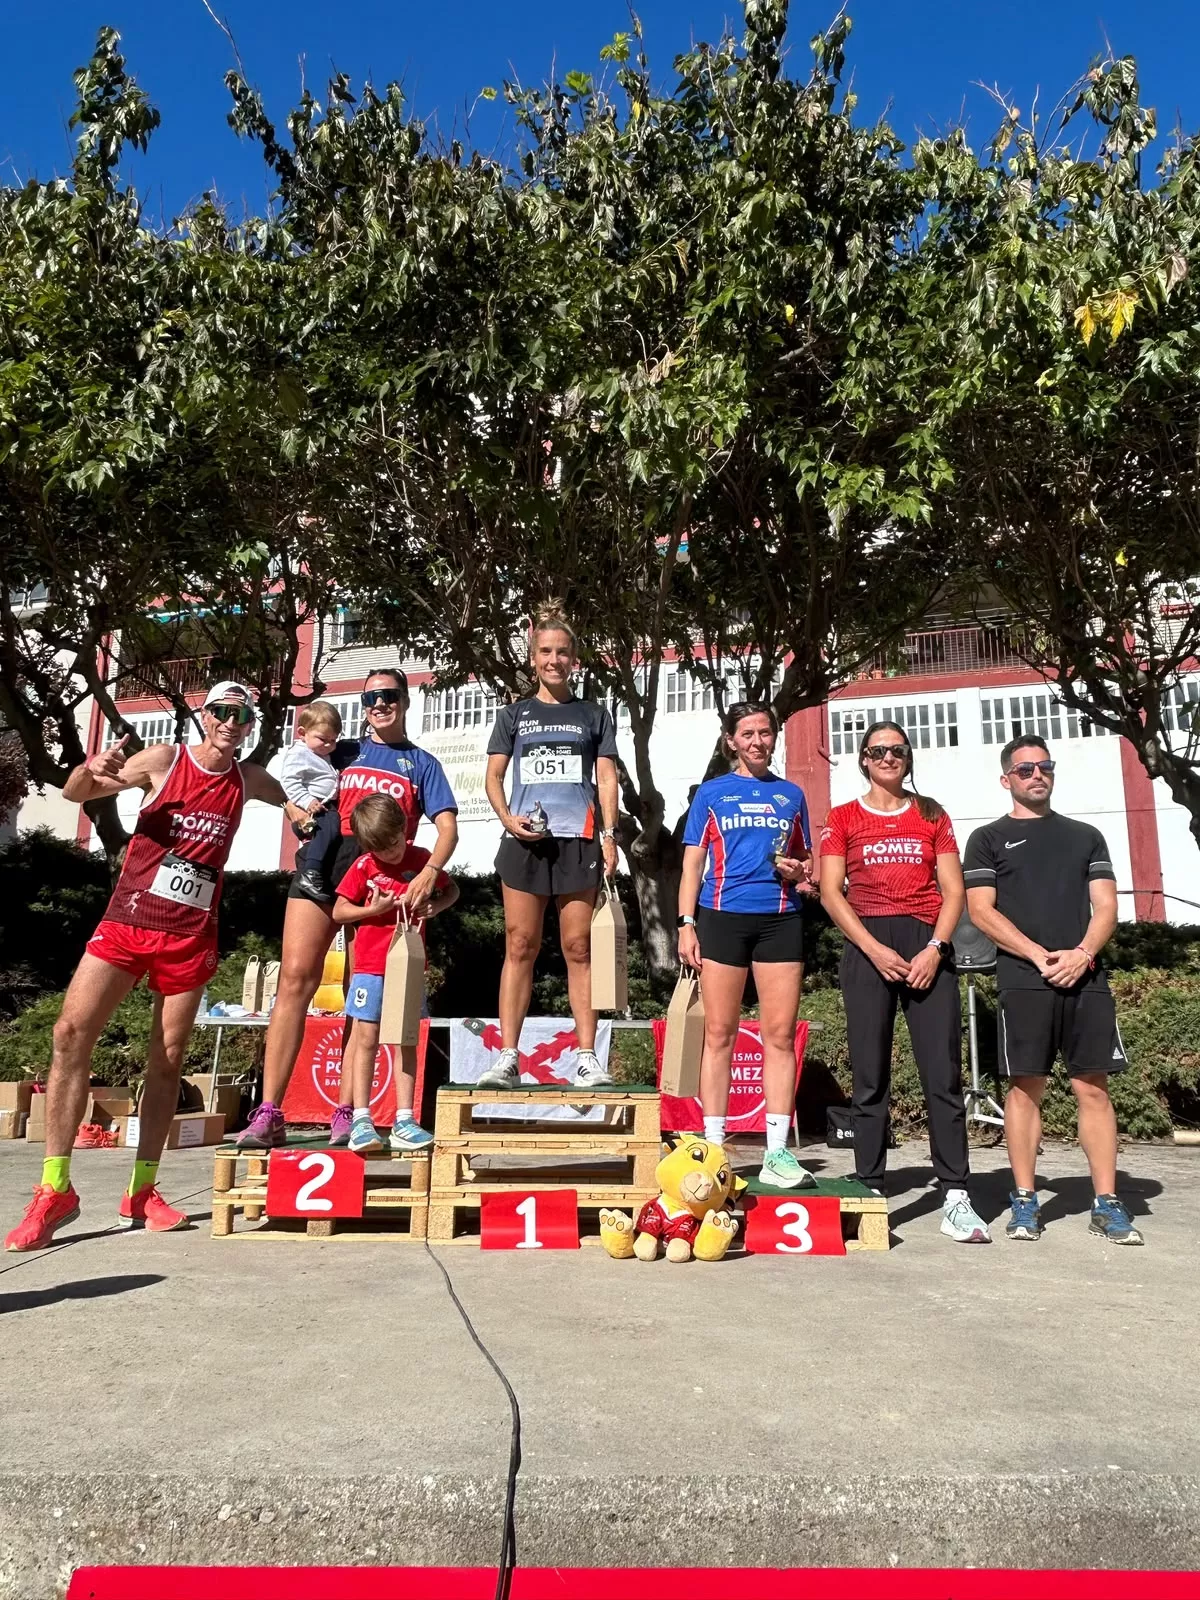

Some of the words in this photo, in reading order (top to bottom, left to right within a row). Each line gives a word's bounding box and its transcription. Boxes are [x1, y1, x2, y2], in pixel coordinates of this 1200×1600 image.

[519, 720, 539, 728] RUN
[519, 726, 542, 736] CLUB
[544, 725, 582, 734] FITNESS
[535, 759, 565, 775] 051
[454, 771, 485, 794] Nogu
[171, 812, 229, 837] PÓMEZ
[721, 813, 789, 831] hinaco
[169, 829, 224, 846] BARBASTRO
[863, 841, 923, 856] PÓMEZ
[864, 856, 923, 866] BARBASTRO
[169, 875, 203, 899] 001
[733, 1052, 762, 1061] ISMO
[731, 1066, 762, 1081] MEZ
[729, 1086, 762, 1094] ASTRO
[295, 1152, 336, 1211] 2
[515, 1196, 544, 1249] 1
[775, 1201, 813, 1253] 3
